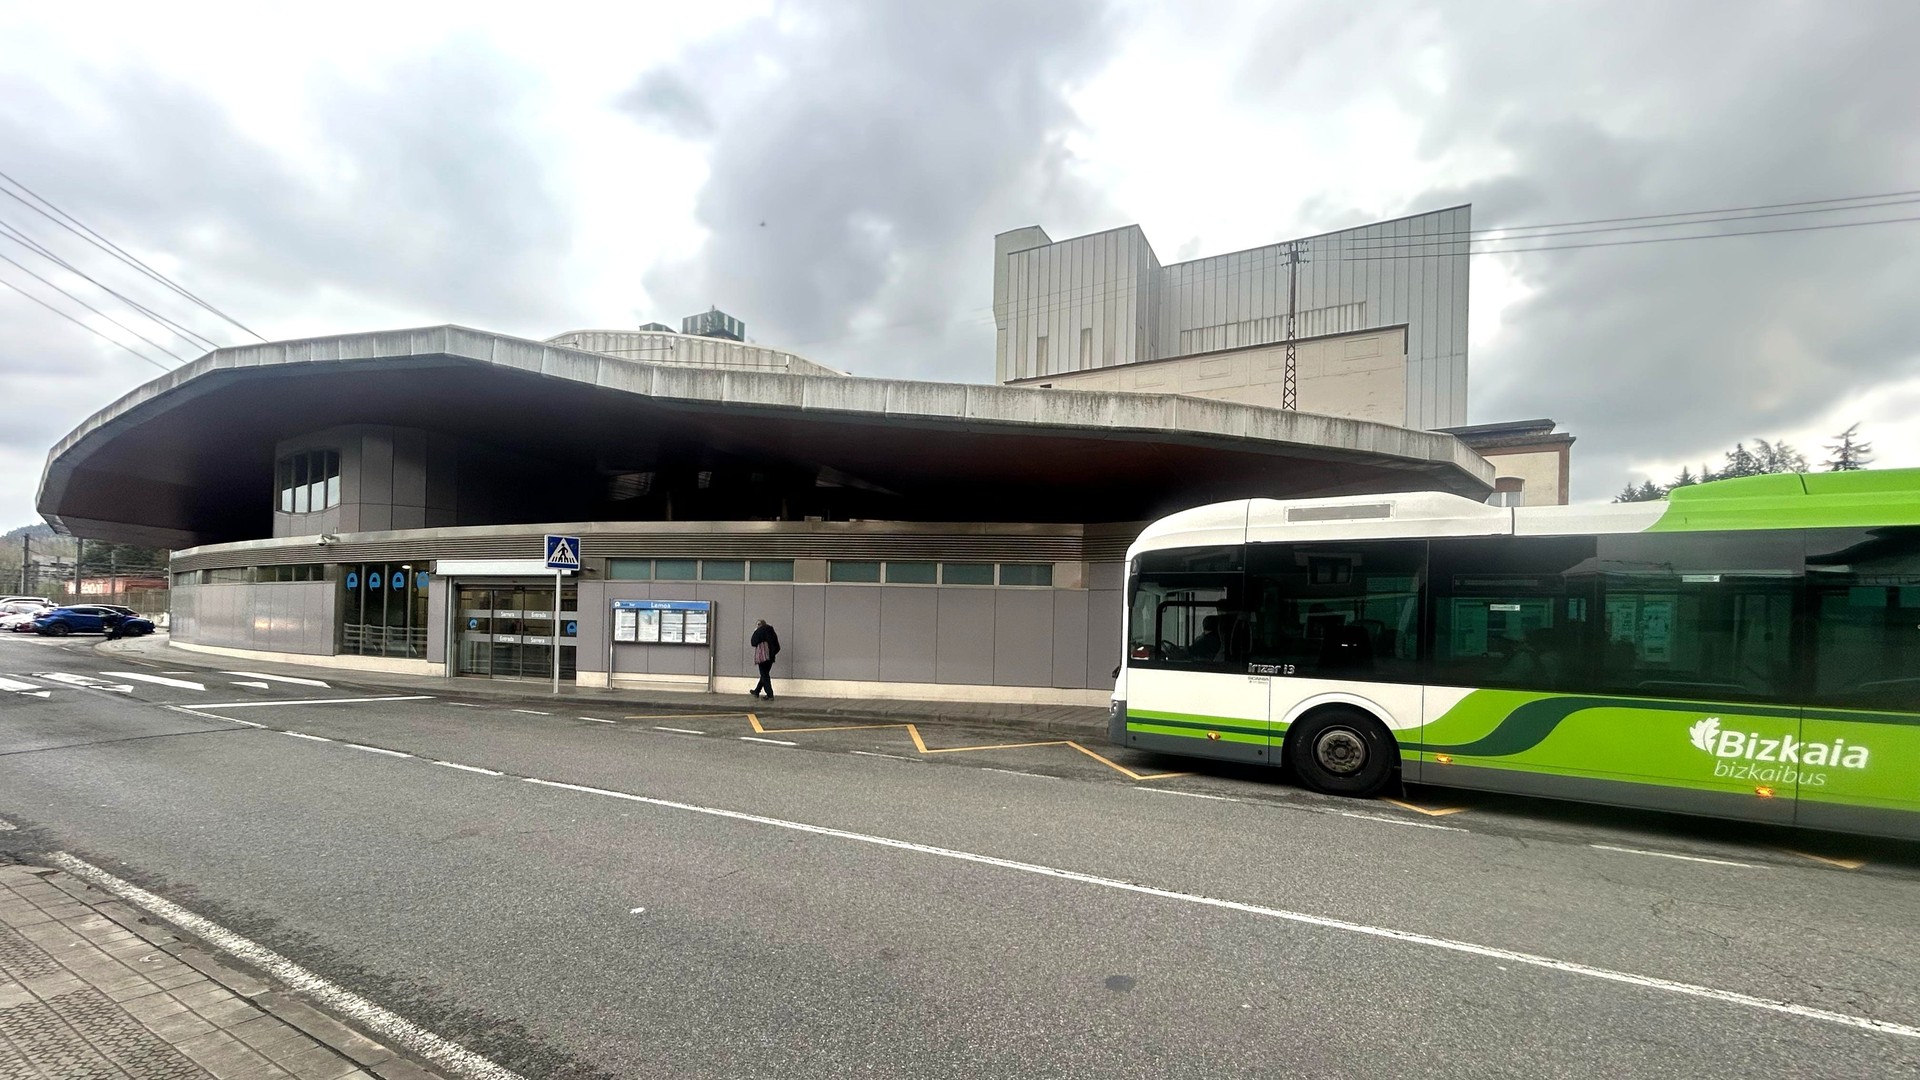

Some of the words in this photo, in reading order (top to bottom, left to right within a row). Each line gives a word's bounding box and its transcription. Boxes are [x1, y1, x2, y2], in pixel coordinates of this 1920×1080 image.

[1283, 664, 1295, 675] i3
[1716, 730, 1870, 769] Bizkaia
[1714, 760, 1827, 786] bizkaibus
